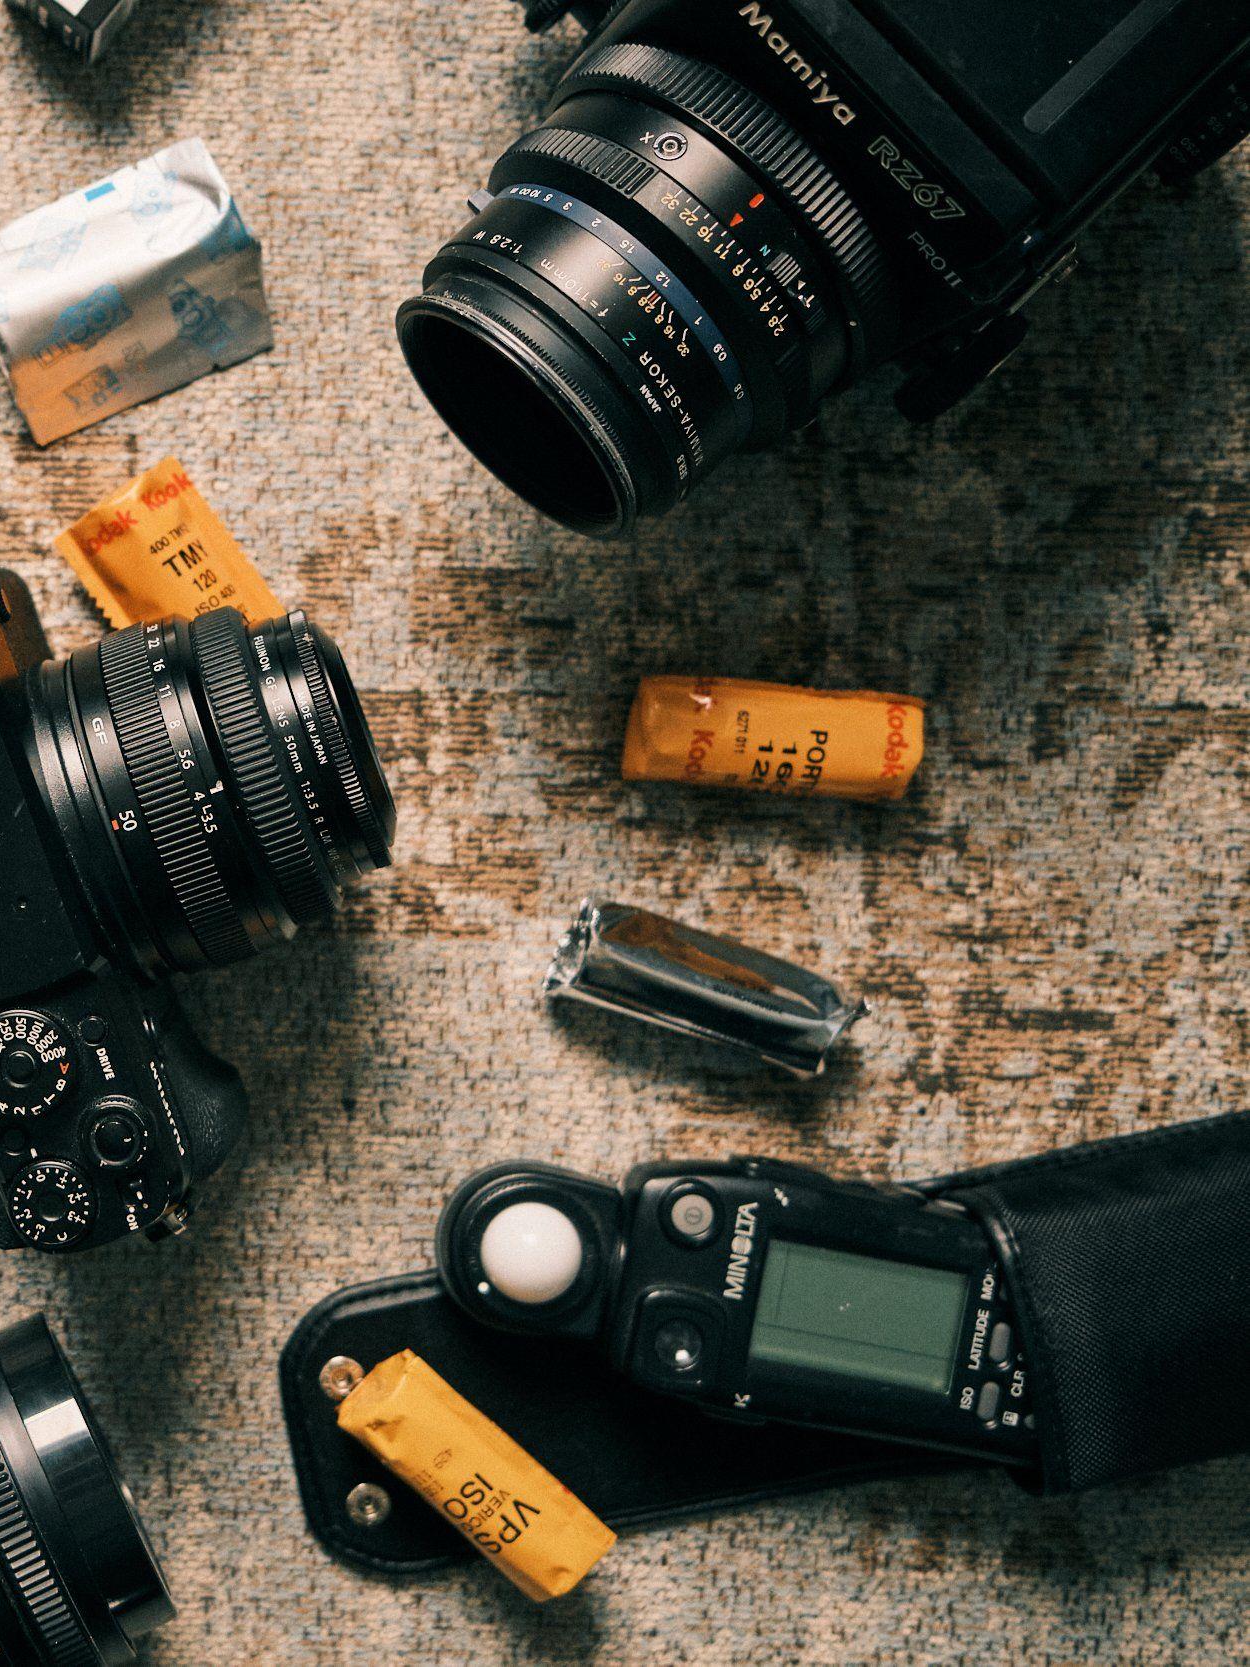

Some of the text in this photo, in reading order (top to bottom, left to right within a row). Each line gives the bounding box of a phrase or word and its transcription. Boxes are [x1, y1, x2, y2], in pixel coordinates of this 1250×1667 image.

[739, 2, 856, 126] Mamiya
[639, 131, 654, 144] X
[867, 135, 966, 219] RZ67
[489, 234, 524, 254] 1:2.8
[661, 192, 745, 277] 32 22 16 11 8
[908, 231, 964, 289] PRO II
[619, 239, 636, 255] 1.5
[655, 271, 672, 288] 1.2
[713, 343, 727, 362] 0.9
[613, 272, 627, 286] 16
[663, 324, 677, 340] 16
[676, 341, 690, 357] 32
[639, 384, 662, 413] JAPAN
[150, 535, 170, 555] 400
[162, 539, 208, 577] TMY
[193, 569, 217, 592] 120
[220, 584, 236, 599] 400
[148, 637, 160, 649] 22
[153, 658, 165, 672] 16
[159, 685, 172, 698] 11
[92, 717, 108, 745] GF
[170, 719, 181, 729] 8
[306, 720, 316, 734] IN
[254, 635, 271, 671] FUJINON
[265, 676, 277, 691] GF
[271, 696, 289, 728] LENS
[284, 735, 303, 774] 50mm
[301, 781, 319, 810] 1:3.5
[320, 829, 332, 844] LM
[310, 733, 328, 765] JAPAN
[179, 749, 194, 770] 5.6
[119, 810, 137, 831] 50
[15, 1017, 26, 1039] 500
[27, 1021, 44, 1045] 1000
[35, 1030, 58, 1053] 2000
[41, 1046, 66, 1063] 4000
[96, 1047, 115, 1080] DRIVE
[59, 1062, 70, 1074] A
[55, 1079, 66, 1091] B
[43, 1093, 55, 1105] T
[126, 1214, 139, 1231] ON
[723, 1202, 759, 1299] MINOLTA
[968, 1308, 990, 1371] LATITUDE
[1011, 1370, 1026, 1398] CLR
[960, 1386, 974, 1410] ISO
[444, 1472, 494, 1520] ISO
[473, 1499, 541, 1555] VPS
